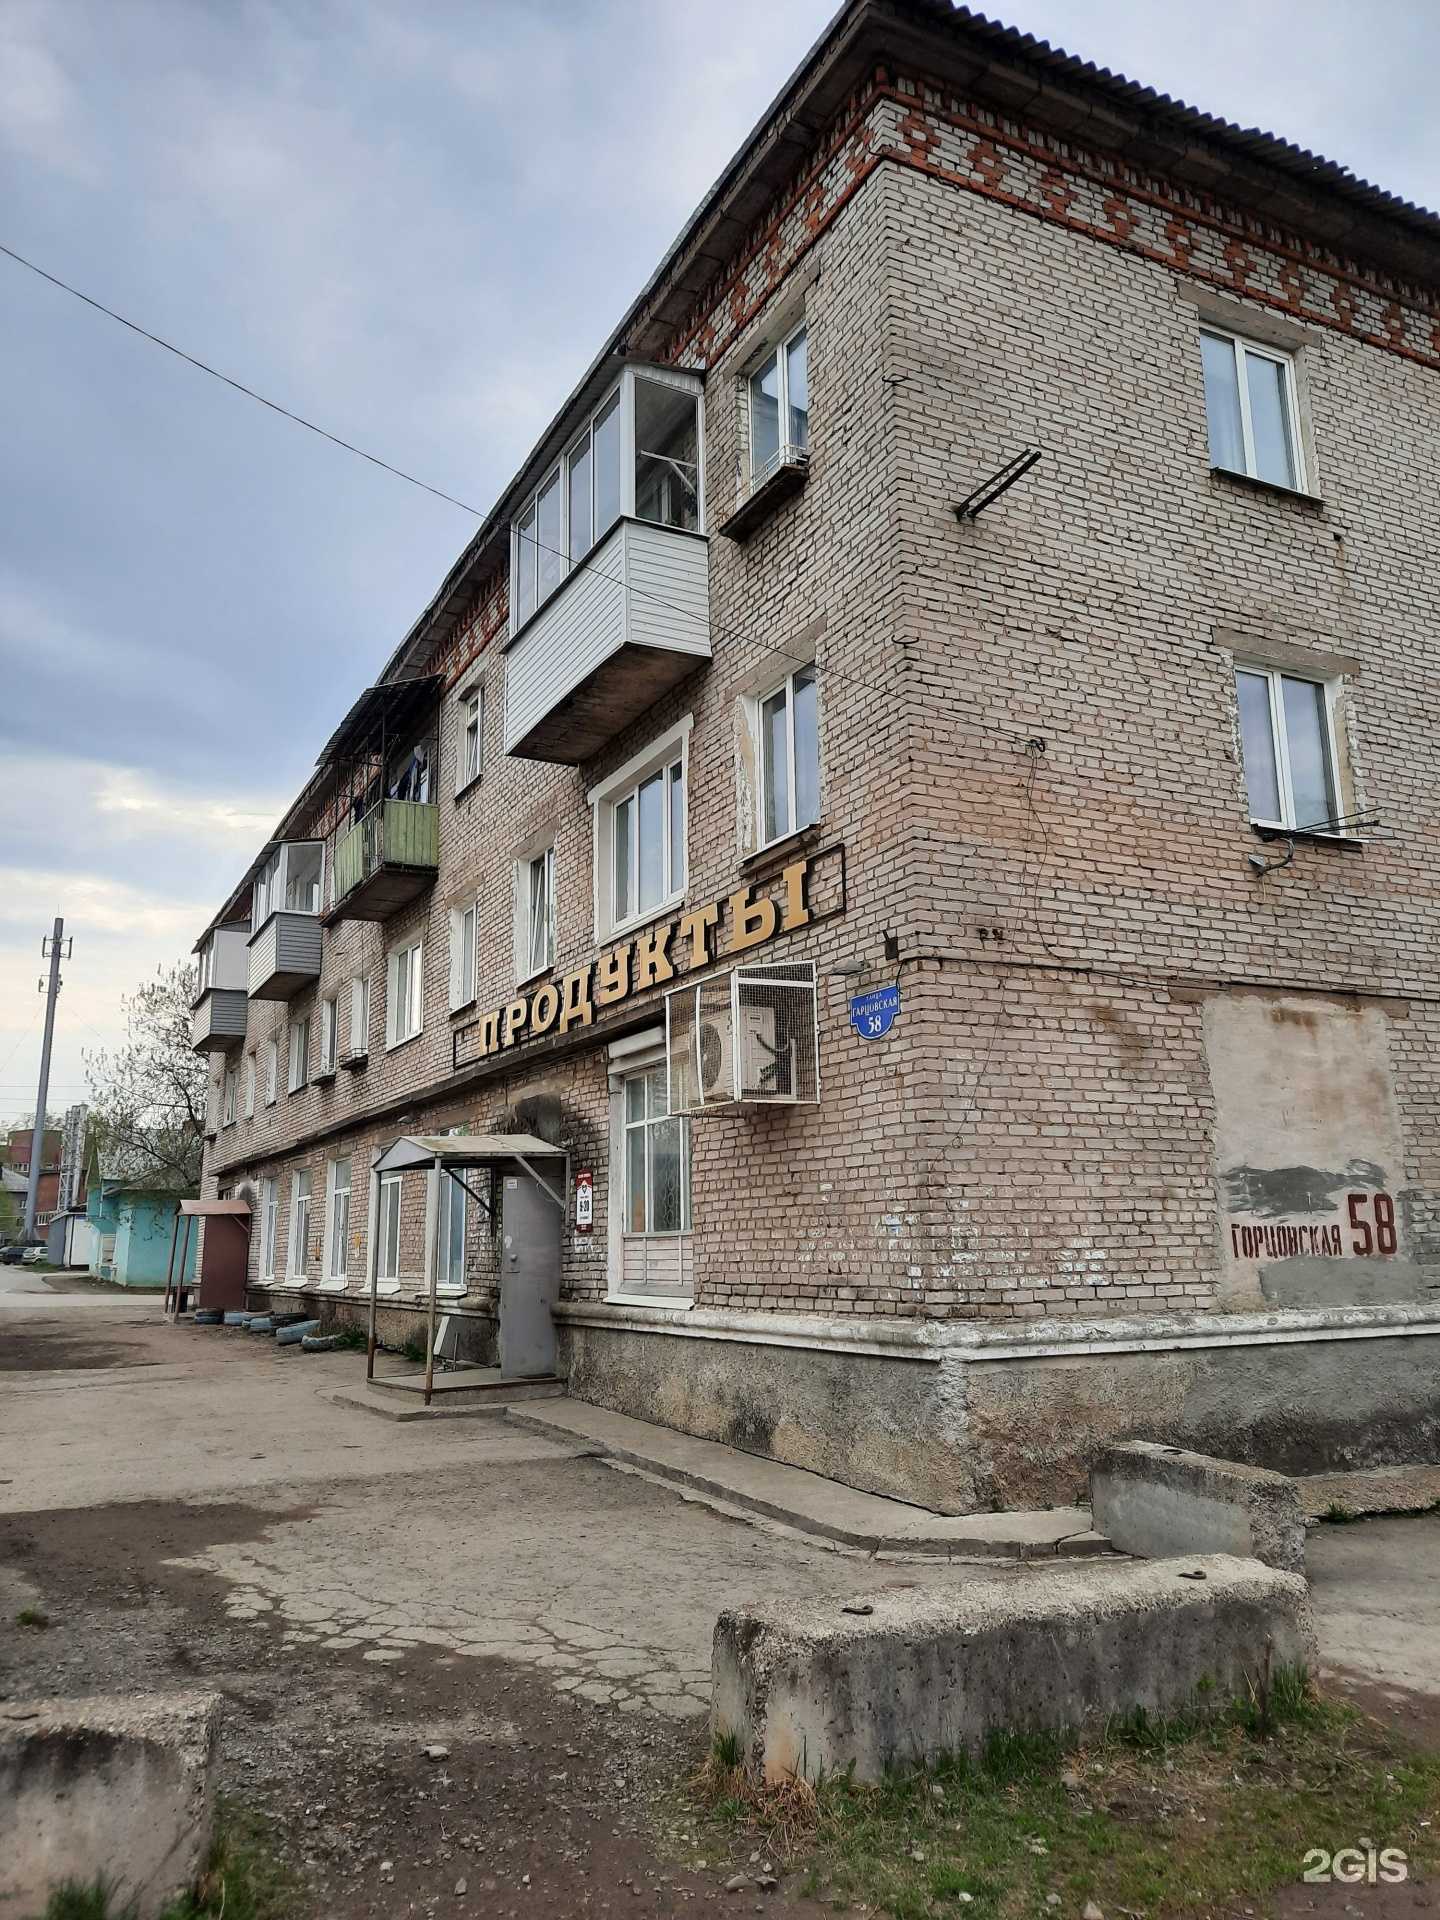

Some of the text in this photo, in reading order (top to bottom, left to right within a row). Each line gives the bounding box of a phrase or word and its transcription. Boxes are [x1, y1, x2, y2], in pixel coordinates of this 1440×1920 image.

[478, 861, 811, 1056] ПРОДУКТЫ
[853, 997, 897, 1017] ГАРЦОВСКАЯ
[868, 1015, 882, 1034] 58
[1231, 1194, 1398, 1258] ГОРЦОВСКАЯ 58
